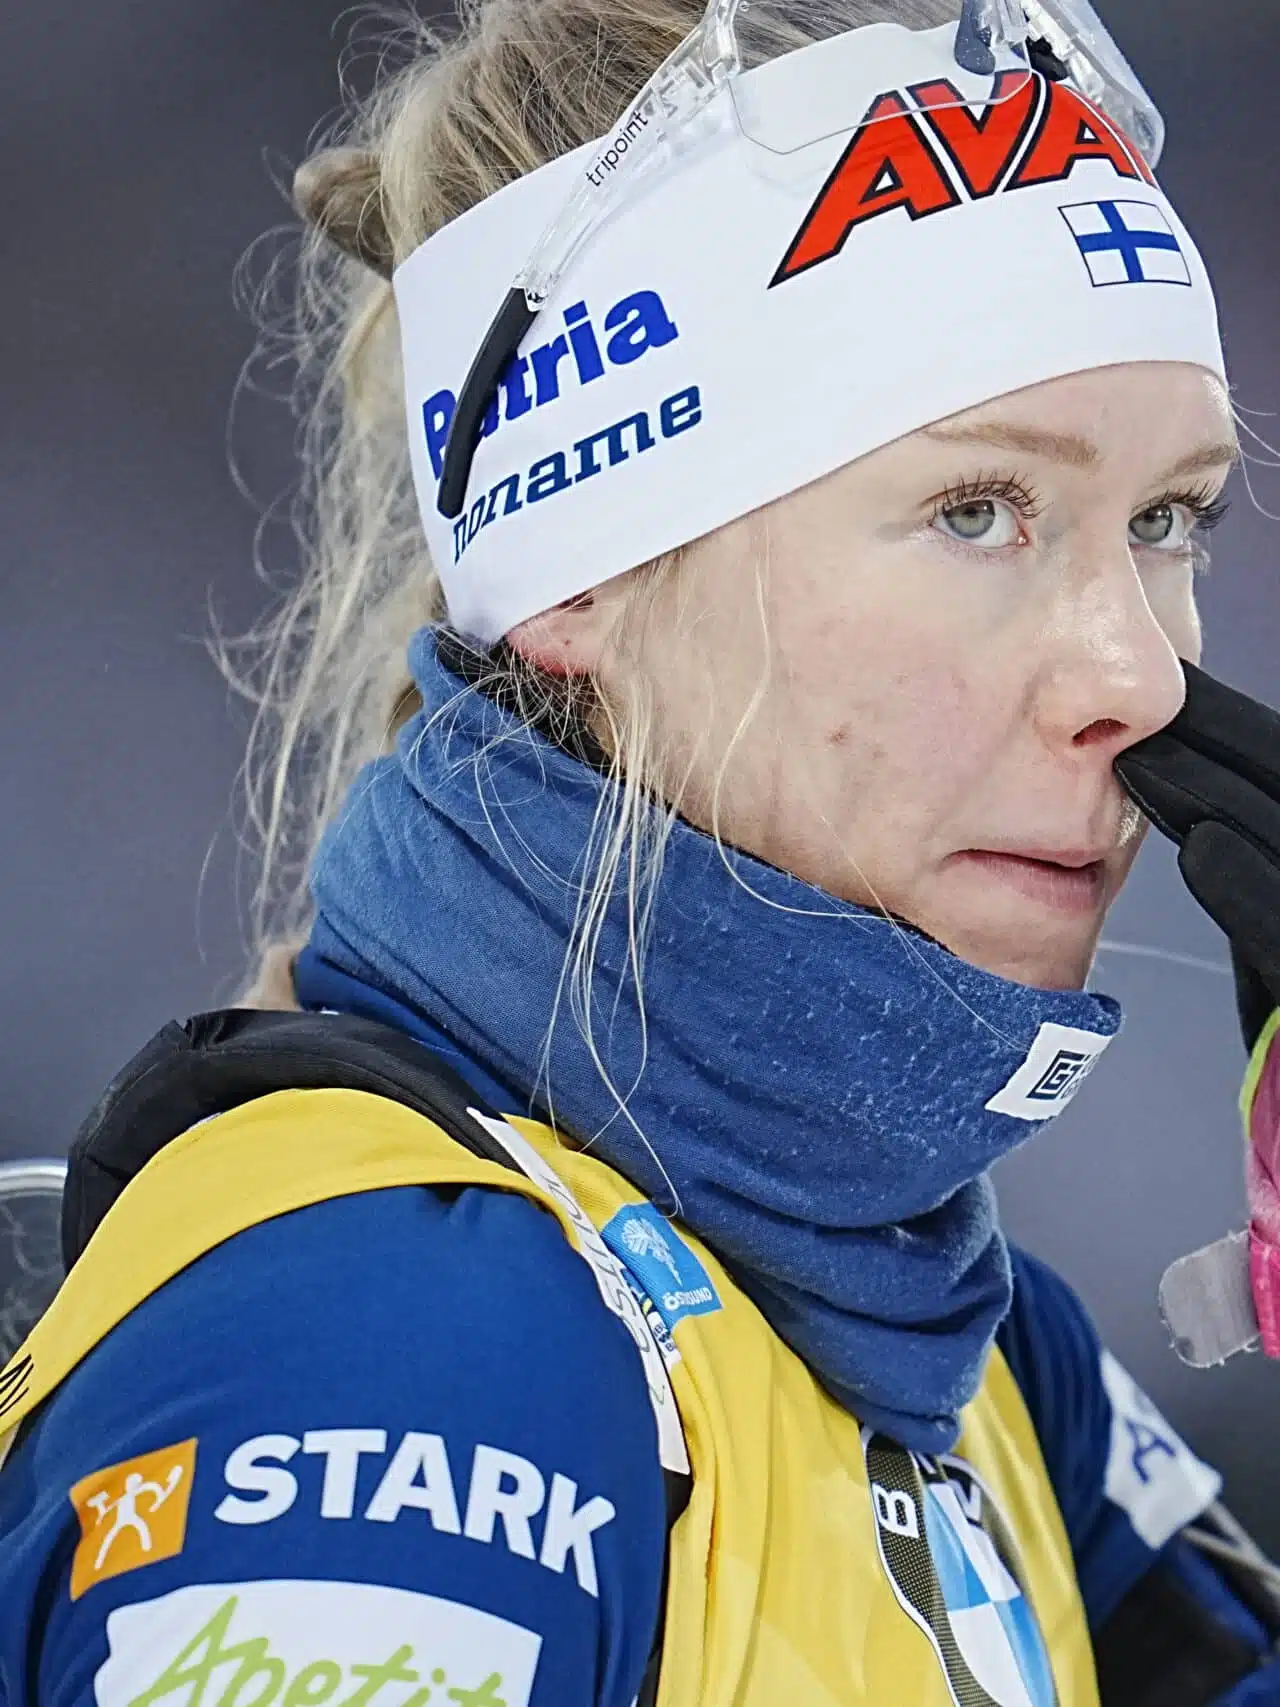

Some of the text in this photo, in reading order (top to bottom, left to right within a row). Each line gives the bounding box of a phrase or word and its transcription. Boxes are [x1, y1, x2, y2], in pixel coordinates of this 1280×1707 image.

[586, 111, 648, 186] tripoint
[768, 70, 1158, 290] AVA
[453, 385, 702, 565] noname
[214, 1428, 616, 1598] STARK
